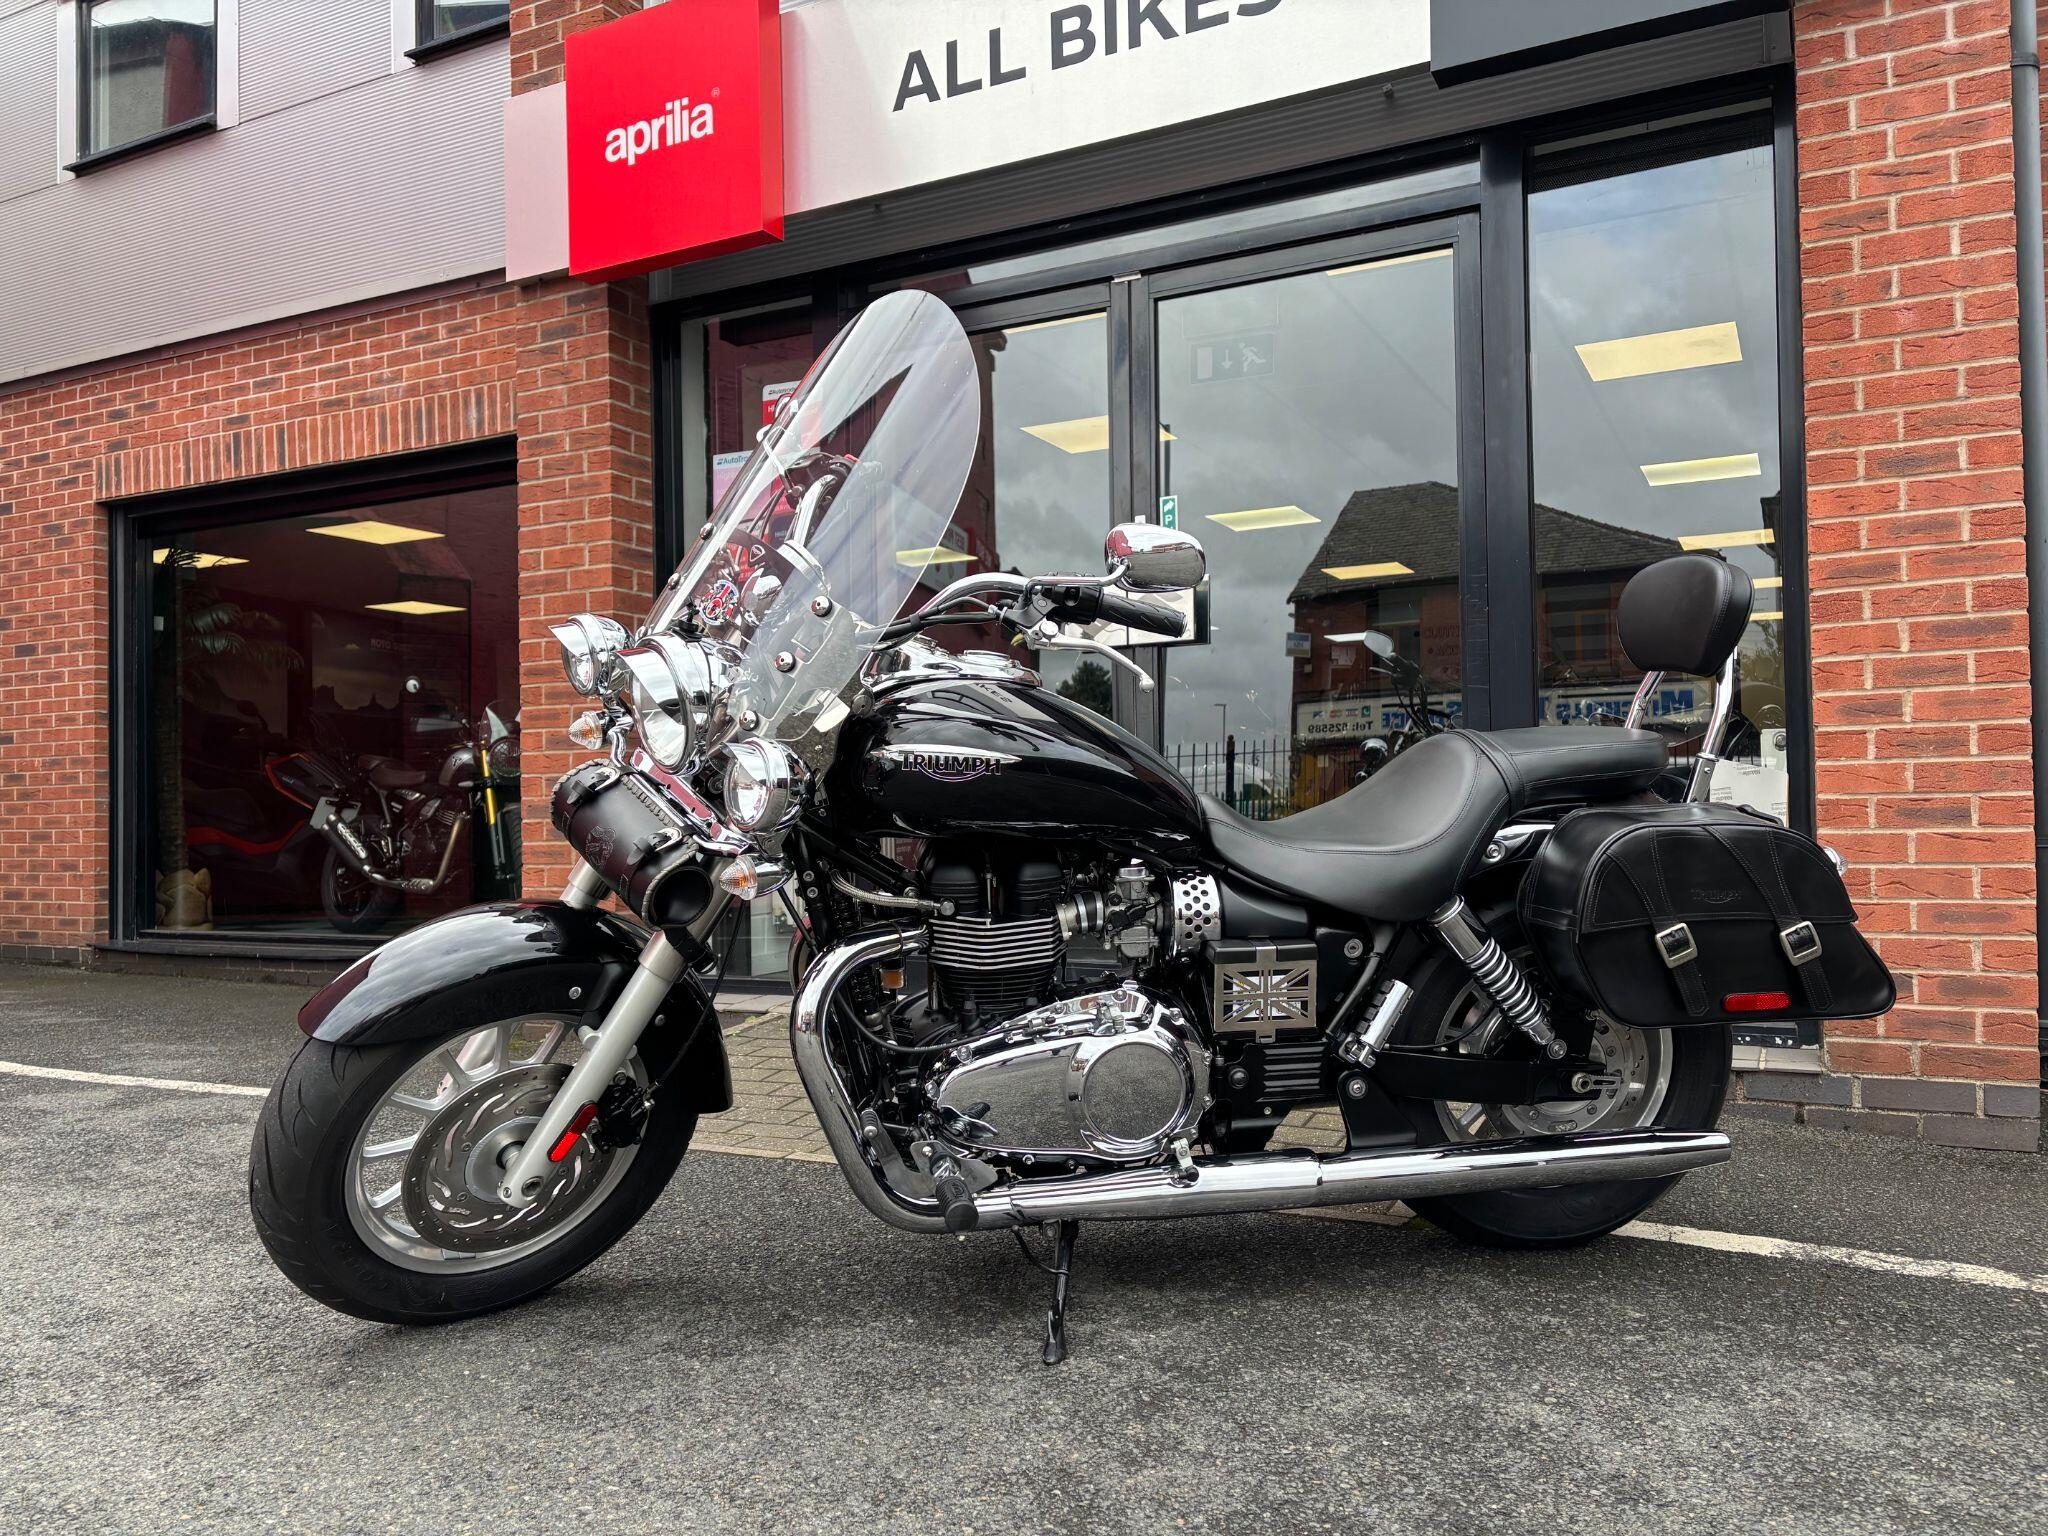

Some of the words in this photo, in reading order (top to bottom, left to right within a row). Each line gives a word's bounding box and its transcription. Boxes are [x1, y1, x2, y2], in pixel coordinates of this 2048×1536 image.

[892, 27, 1027, 113] ALL
[1050, 0, 1282, 70] BIKE
[604, 96, 714, 167] aprilia
[899, 750, 1002, 775] TRIUMPH
